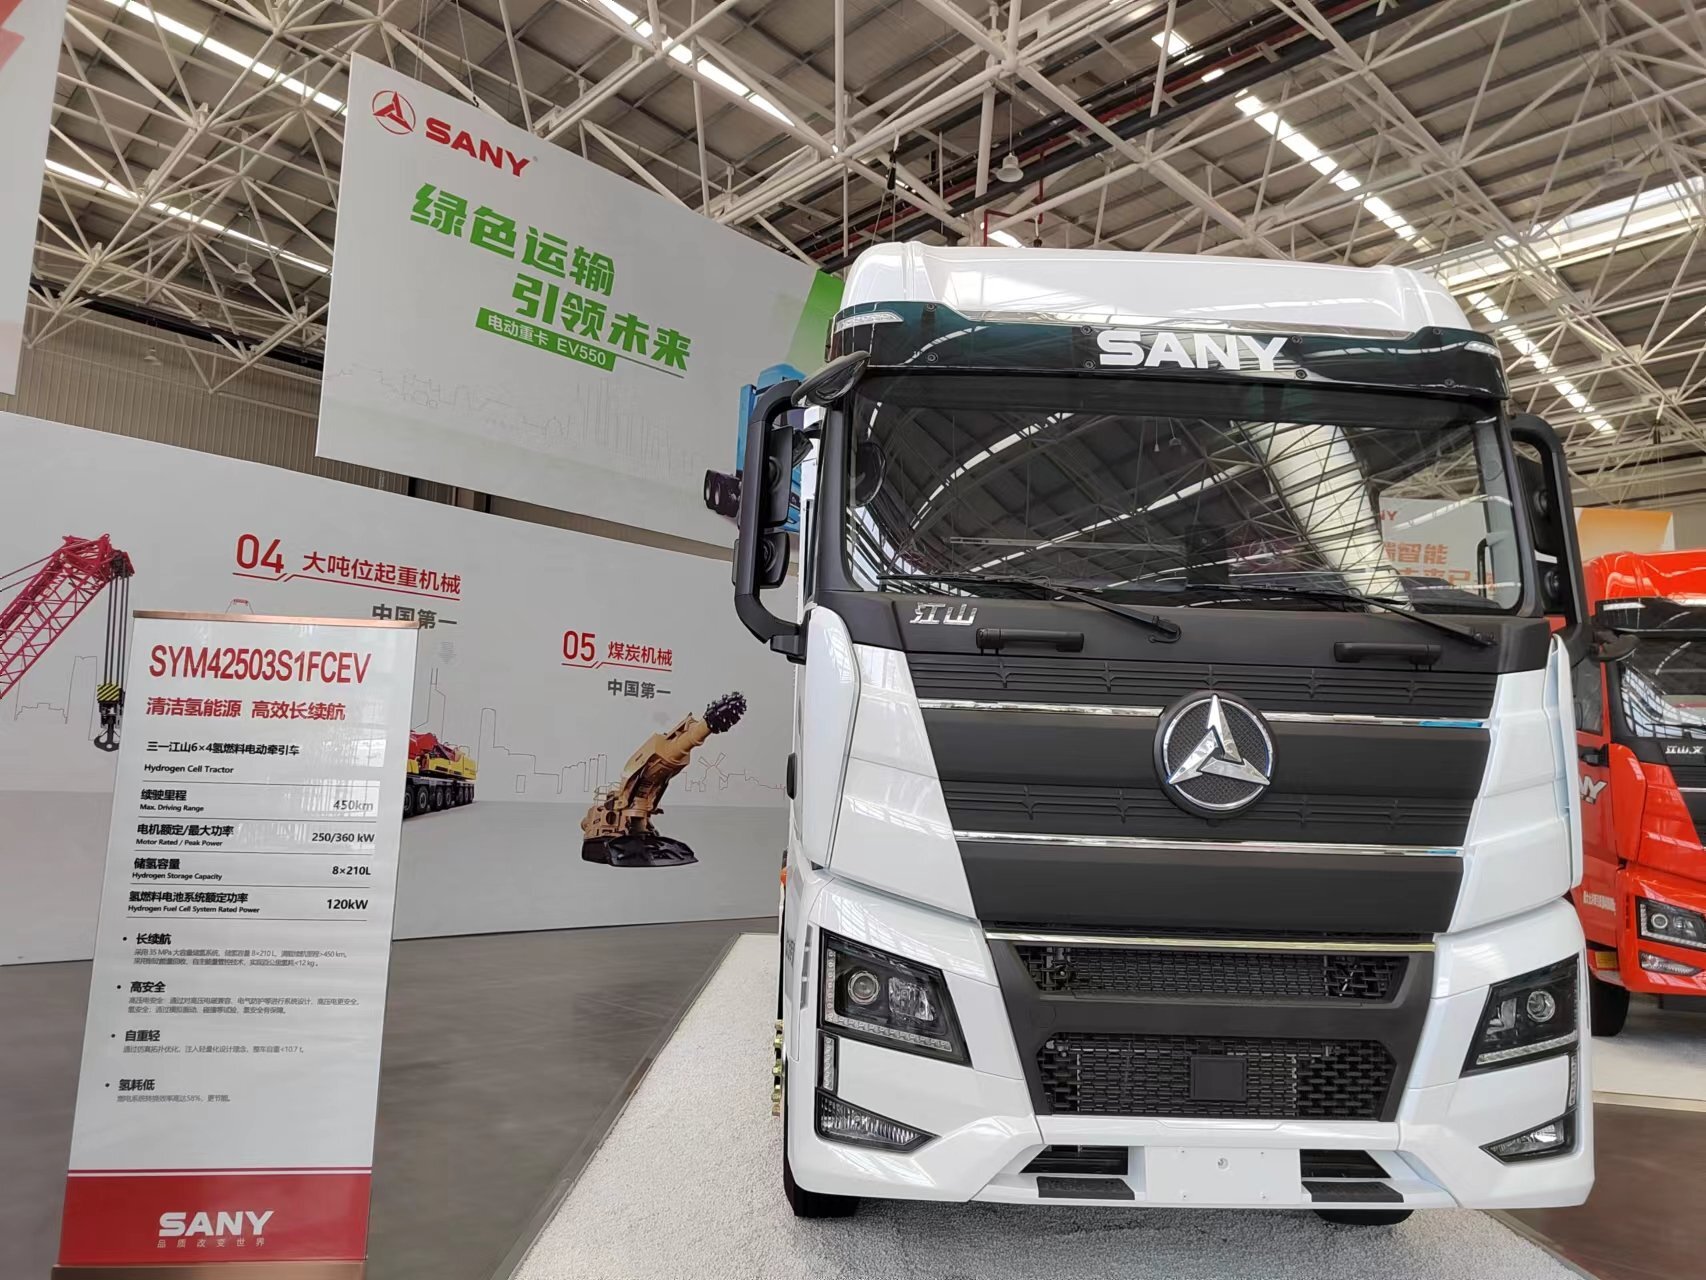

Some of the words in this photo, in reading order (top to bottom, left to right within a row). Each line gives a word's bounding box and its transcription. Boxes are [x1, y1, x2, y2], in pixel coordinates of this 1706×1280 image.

[425, 117, 531, 177] SANY
[410, 183, 615, 296] 绿色运输
[511, 273, 691, 370] 引领未来
[488, 314, 549, 346] 电动重卡
[557, 337, 606, 366] EV550
[1096, 331, 1288, 371] SANY
[236, 534, 284, 573] 04
[302, 551, 461, 595] 大吨位起重机械
[372, 604, 457, 630] 中国第一
[563, 630, 595, 661] 05
[607, 641, 672, 666] 煤炭机械
[149, 644, 371, 683] SYM42503S1FCEV
[607, 678, 671, 699] 中国第一
[146, 697, 242, 717] 清洁氢能源
[251, 700, 346, 720] 高效长续航
[144, 764, 185, 774] Hydrogen
[187, 765, 202, 773] Cell
[158, 804, 181, 812] Driving
[183, 805, 204, 813] Range
[333, 800, 373, 811] 450km
[312, 832, 354, 843] 250/360
[357, 833, 375, 842] kW
[134, 858, 180, 869] 储氢容量
[132, 872, 165, 880] Hydrogen
[167, 872, 193, 880] Storage
[194, 873, 222, 881] Capacity
[128, 905, 161, 913] Hydrogen
[327, 899, 368, 909] 120kW
[136, 933, 172, 945] 长续航
[130, 981, 166, 993] 高安全
[124, 1030, 160, 1042] 自重轻
[118, 1079, 155, 1091] 氢耗低
[158, 1210, 274, 1237] SANY
[157, 1238, 265, 1248] 品质改变世界
